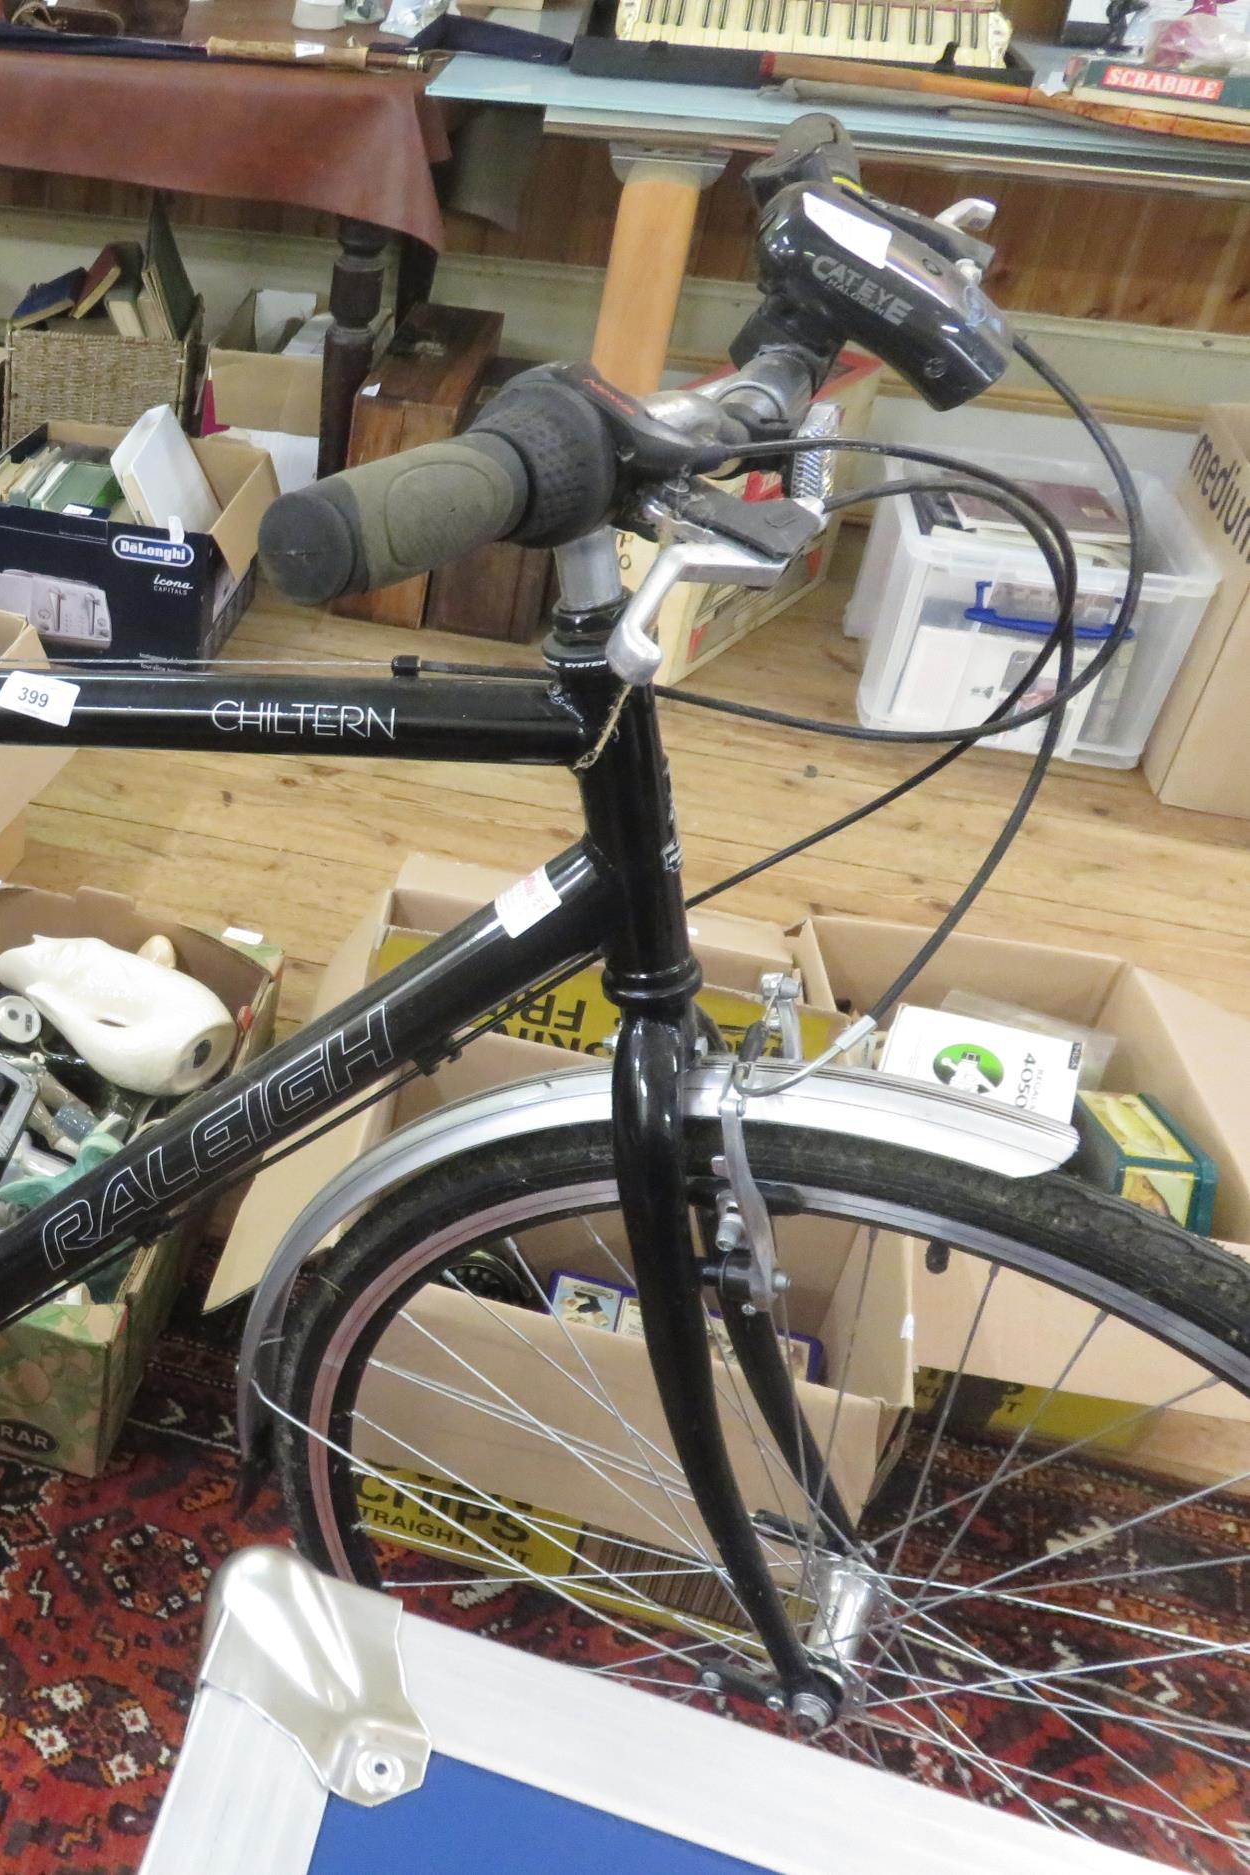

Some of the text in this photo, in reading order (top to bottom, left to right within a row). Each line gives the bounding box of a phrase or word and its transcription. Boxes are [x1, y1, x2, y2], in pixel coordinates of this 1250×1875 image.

[1108, 66, 1220, 100] SCRABBLE
[811, 254, 915, 327] CATEYE
[153, 585, 188, 596] CAPITALS
[17, 686, 50, 708] 399
[211, 699, 397, 741] CHILTERN
[1014, 1051, 1037, 1109] 4050
[42, 1000, 396, 1273] RALEIGH
[0, 1424, 50, 1451] RAR
[356, 1503, 469, 1547] TRAIGHT
